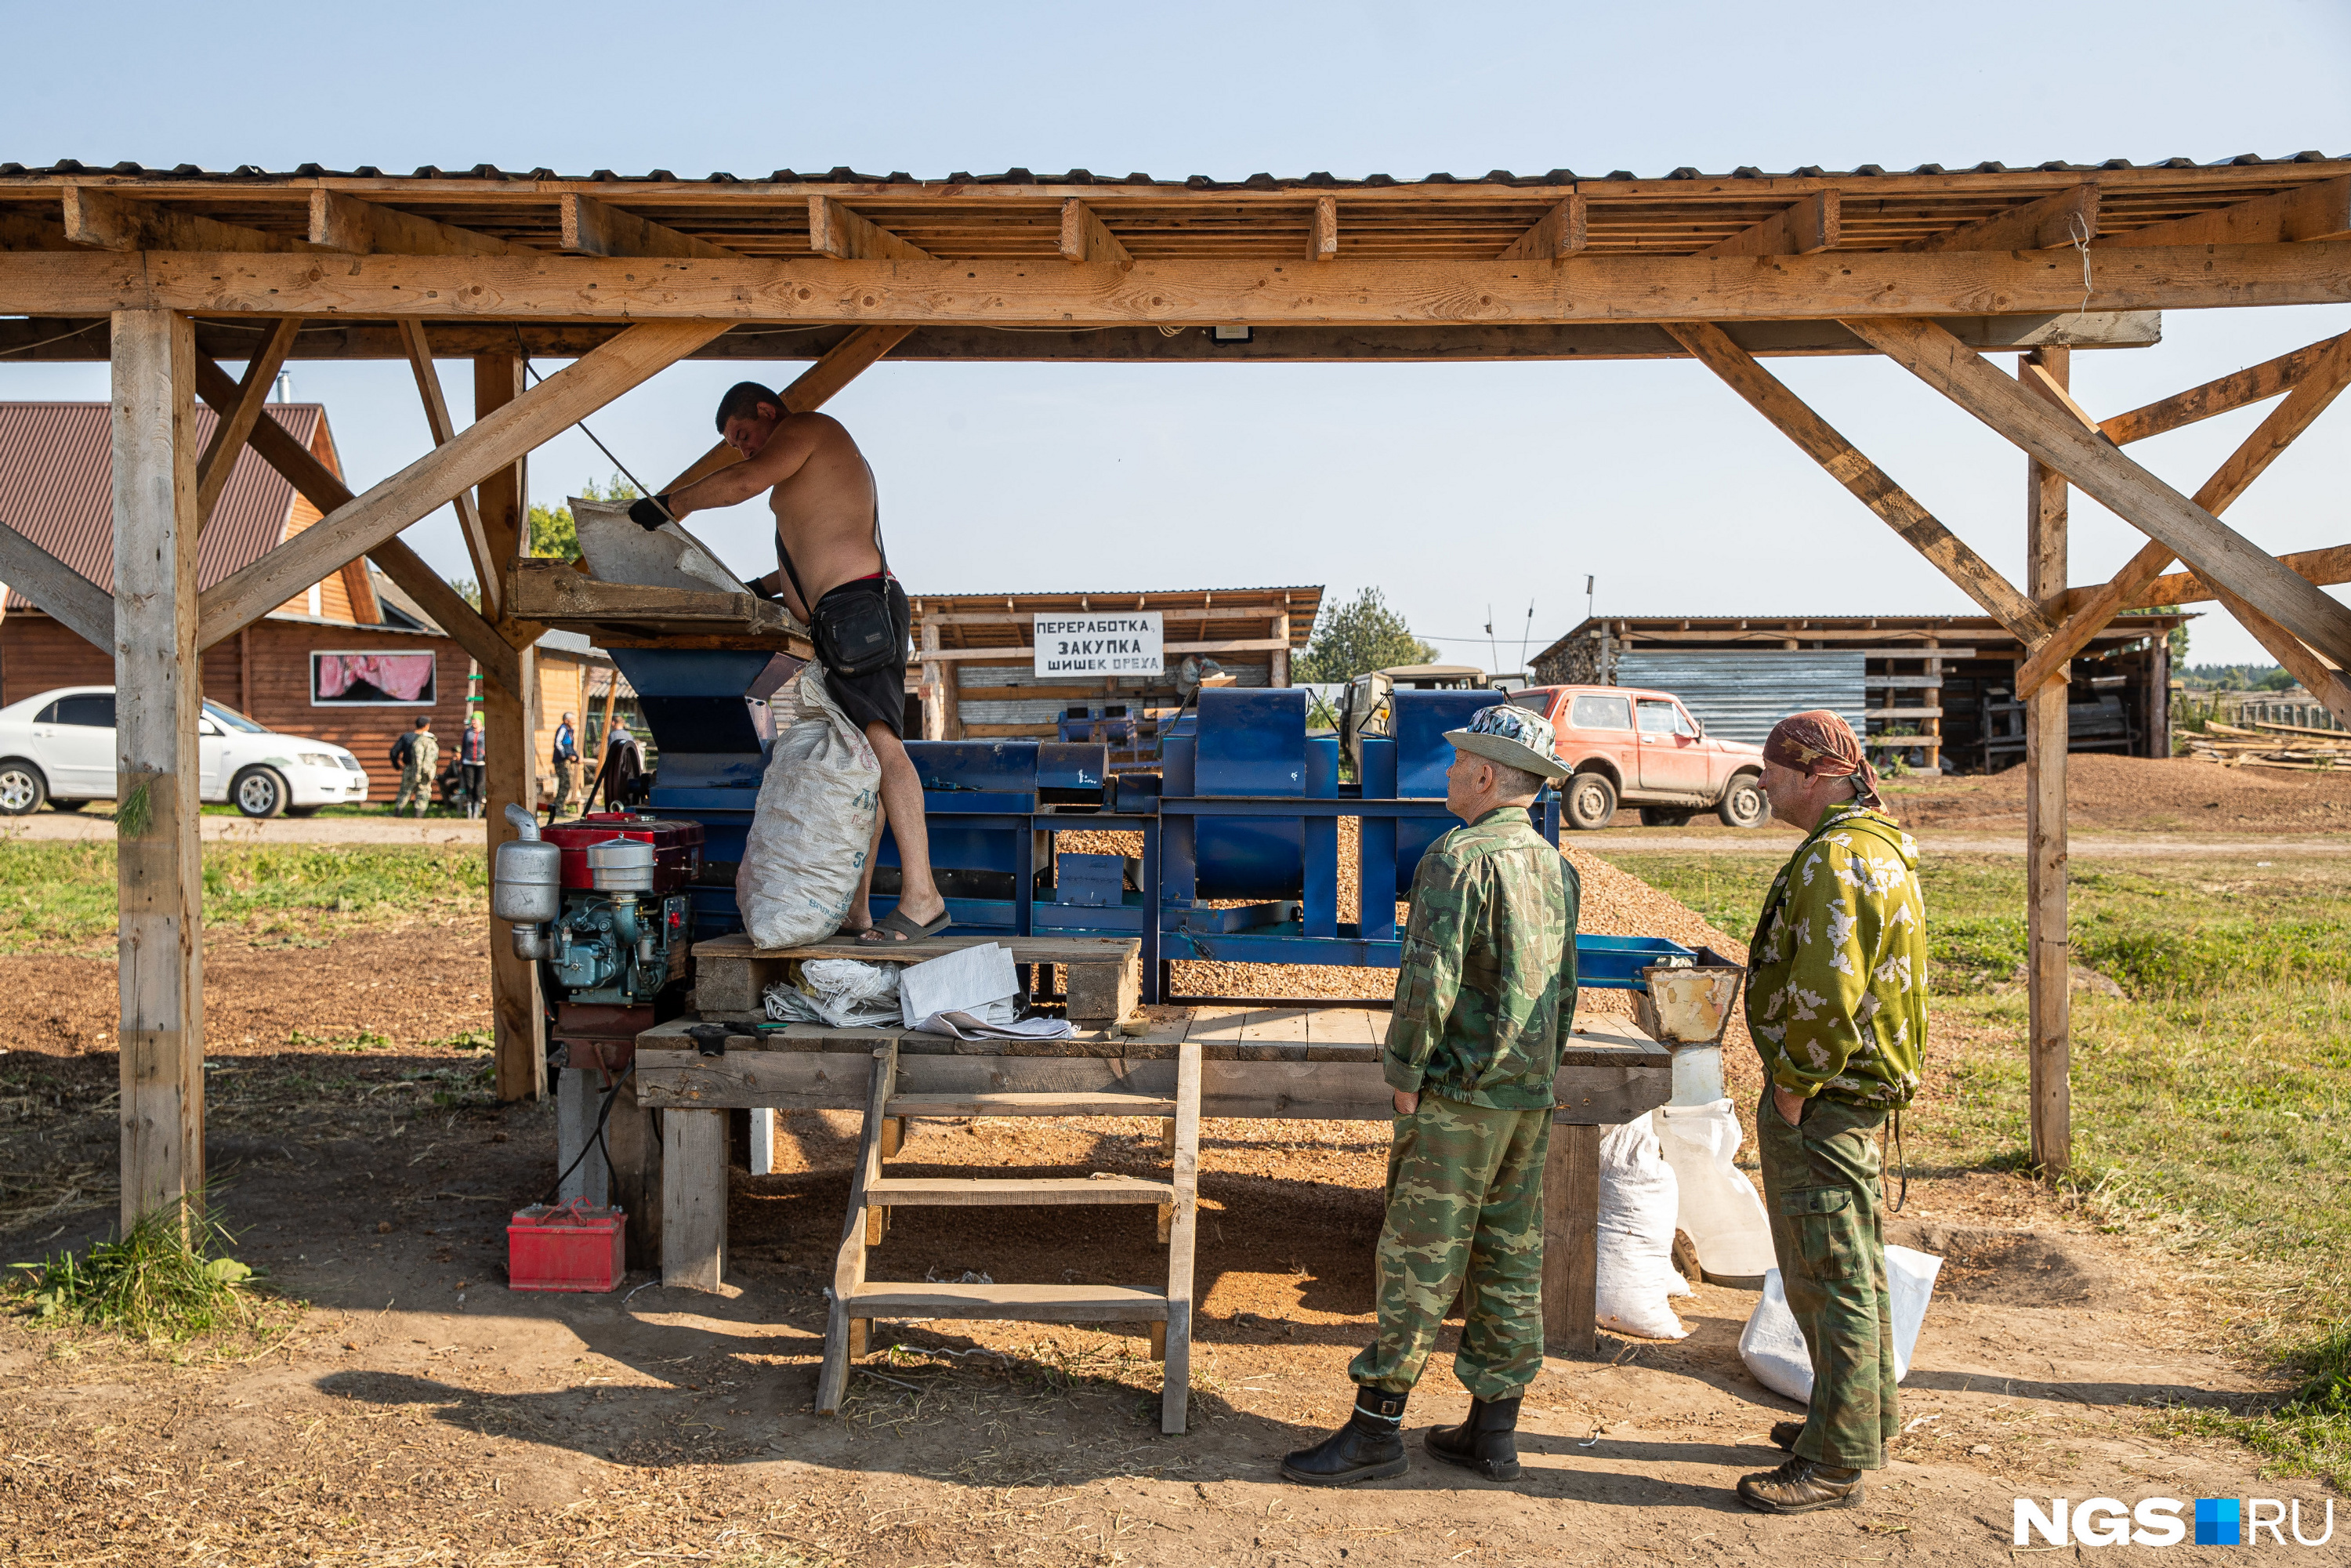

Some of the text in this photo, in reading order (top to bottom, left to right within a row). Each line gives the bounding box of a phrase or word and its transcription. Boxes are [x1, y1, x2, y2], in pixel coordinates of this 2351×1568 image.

[1058, 639, 1141, 655] ЗАКУПКА
[1048, 657, 1158, 671] ШИШЕК ОРЕХА
